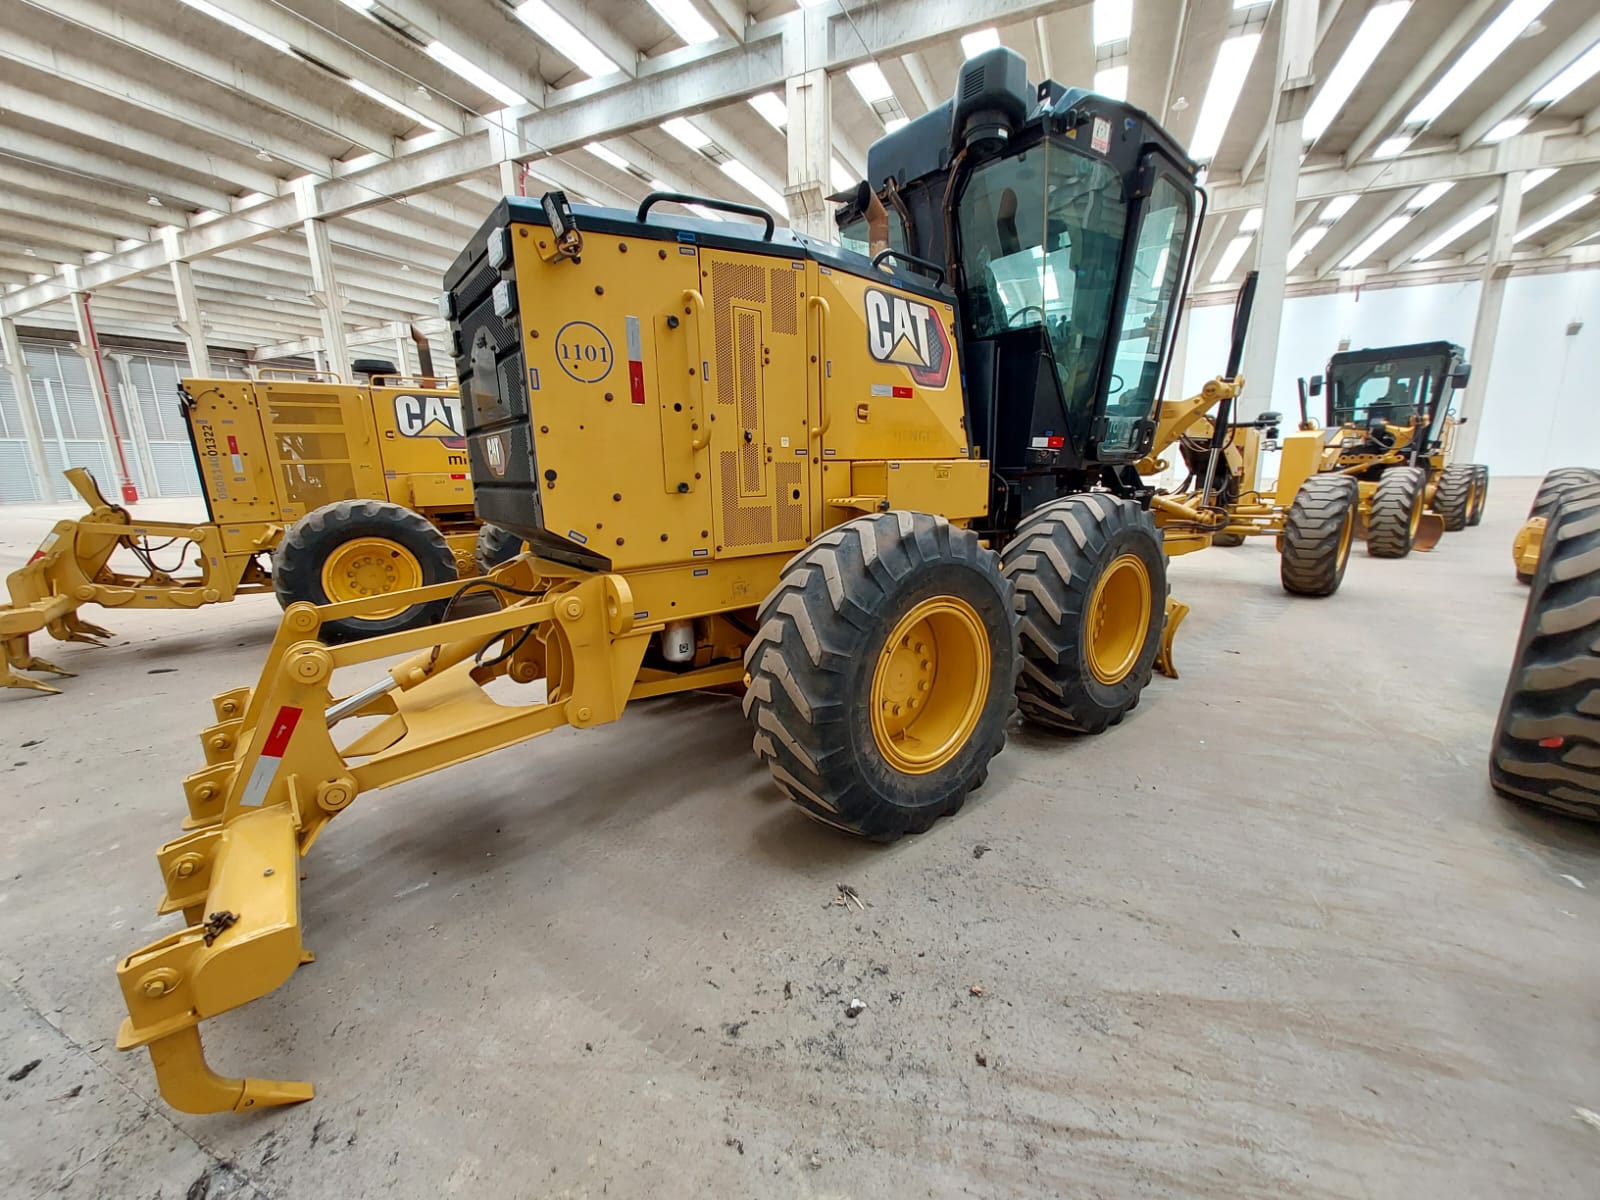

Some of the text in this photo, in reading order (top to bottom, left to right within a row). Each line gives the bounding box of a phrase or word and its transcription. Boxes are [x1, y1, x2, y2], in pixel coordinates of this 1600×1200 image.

[866, 290, 931, 368] CAT
[561, 343, 608, 363] 1101
[395, 395, 465, 437] CAT
[202, 424, 218, 457] 01322
[486, 437, 501, 466] CAT
